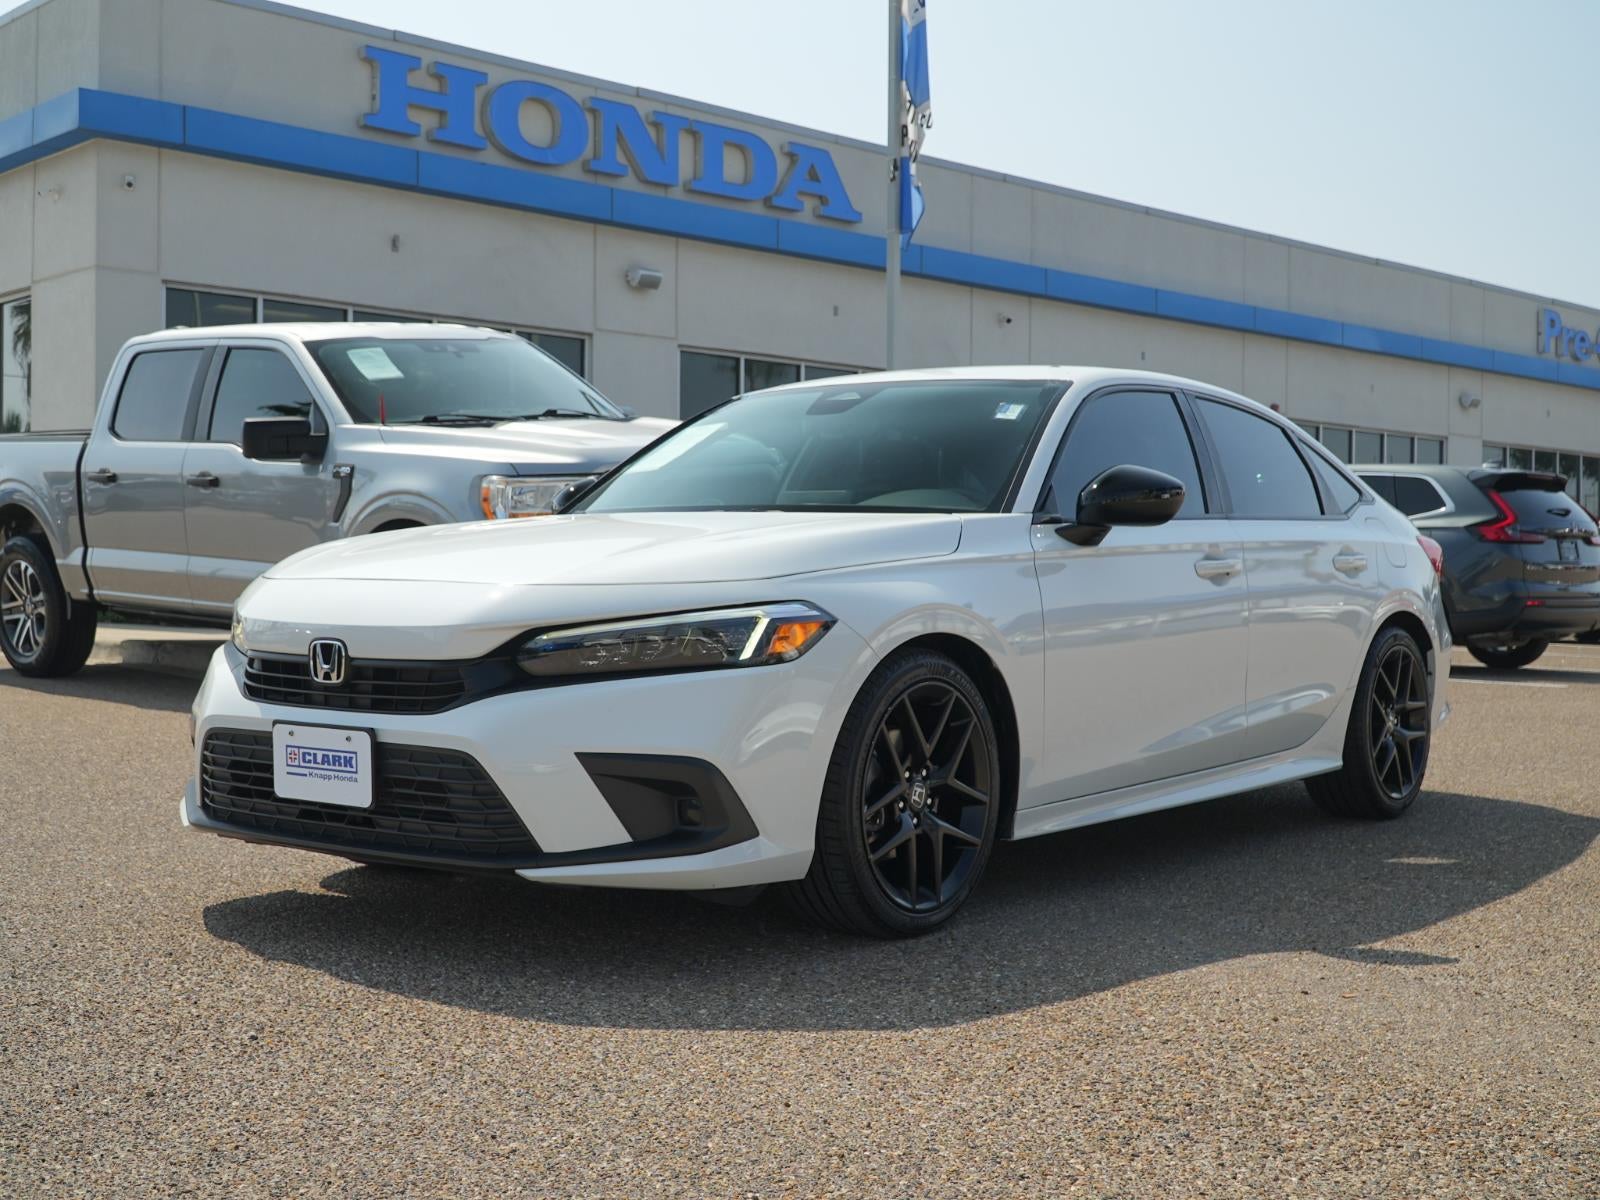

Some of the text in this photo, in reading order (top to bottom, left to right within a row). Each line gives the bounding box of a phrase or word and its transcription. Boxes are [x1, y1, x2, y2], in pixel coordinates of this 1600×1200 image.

[359, 45, 862, 223] HONDA
[1539, 308, 1600, 361] Pre-
[301, 751, 354, 769] CLARK
[308, 770, 358, 783] Knapp Honda
